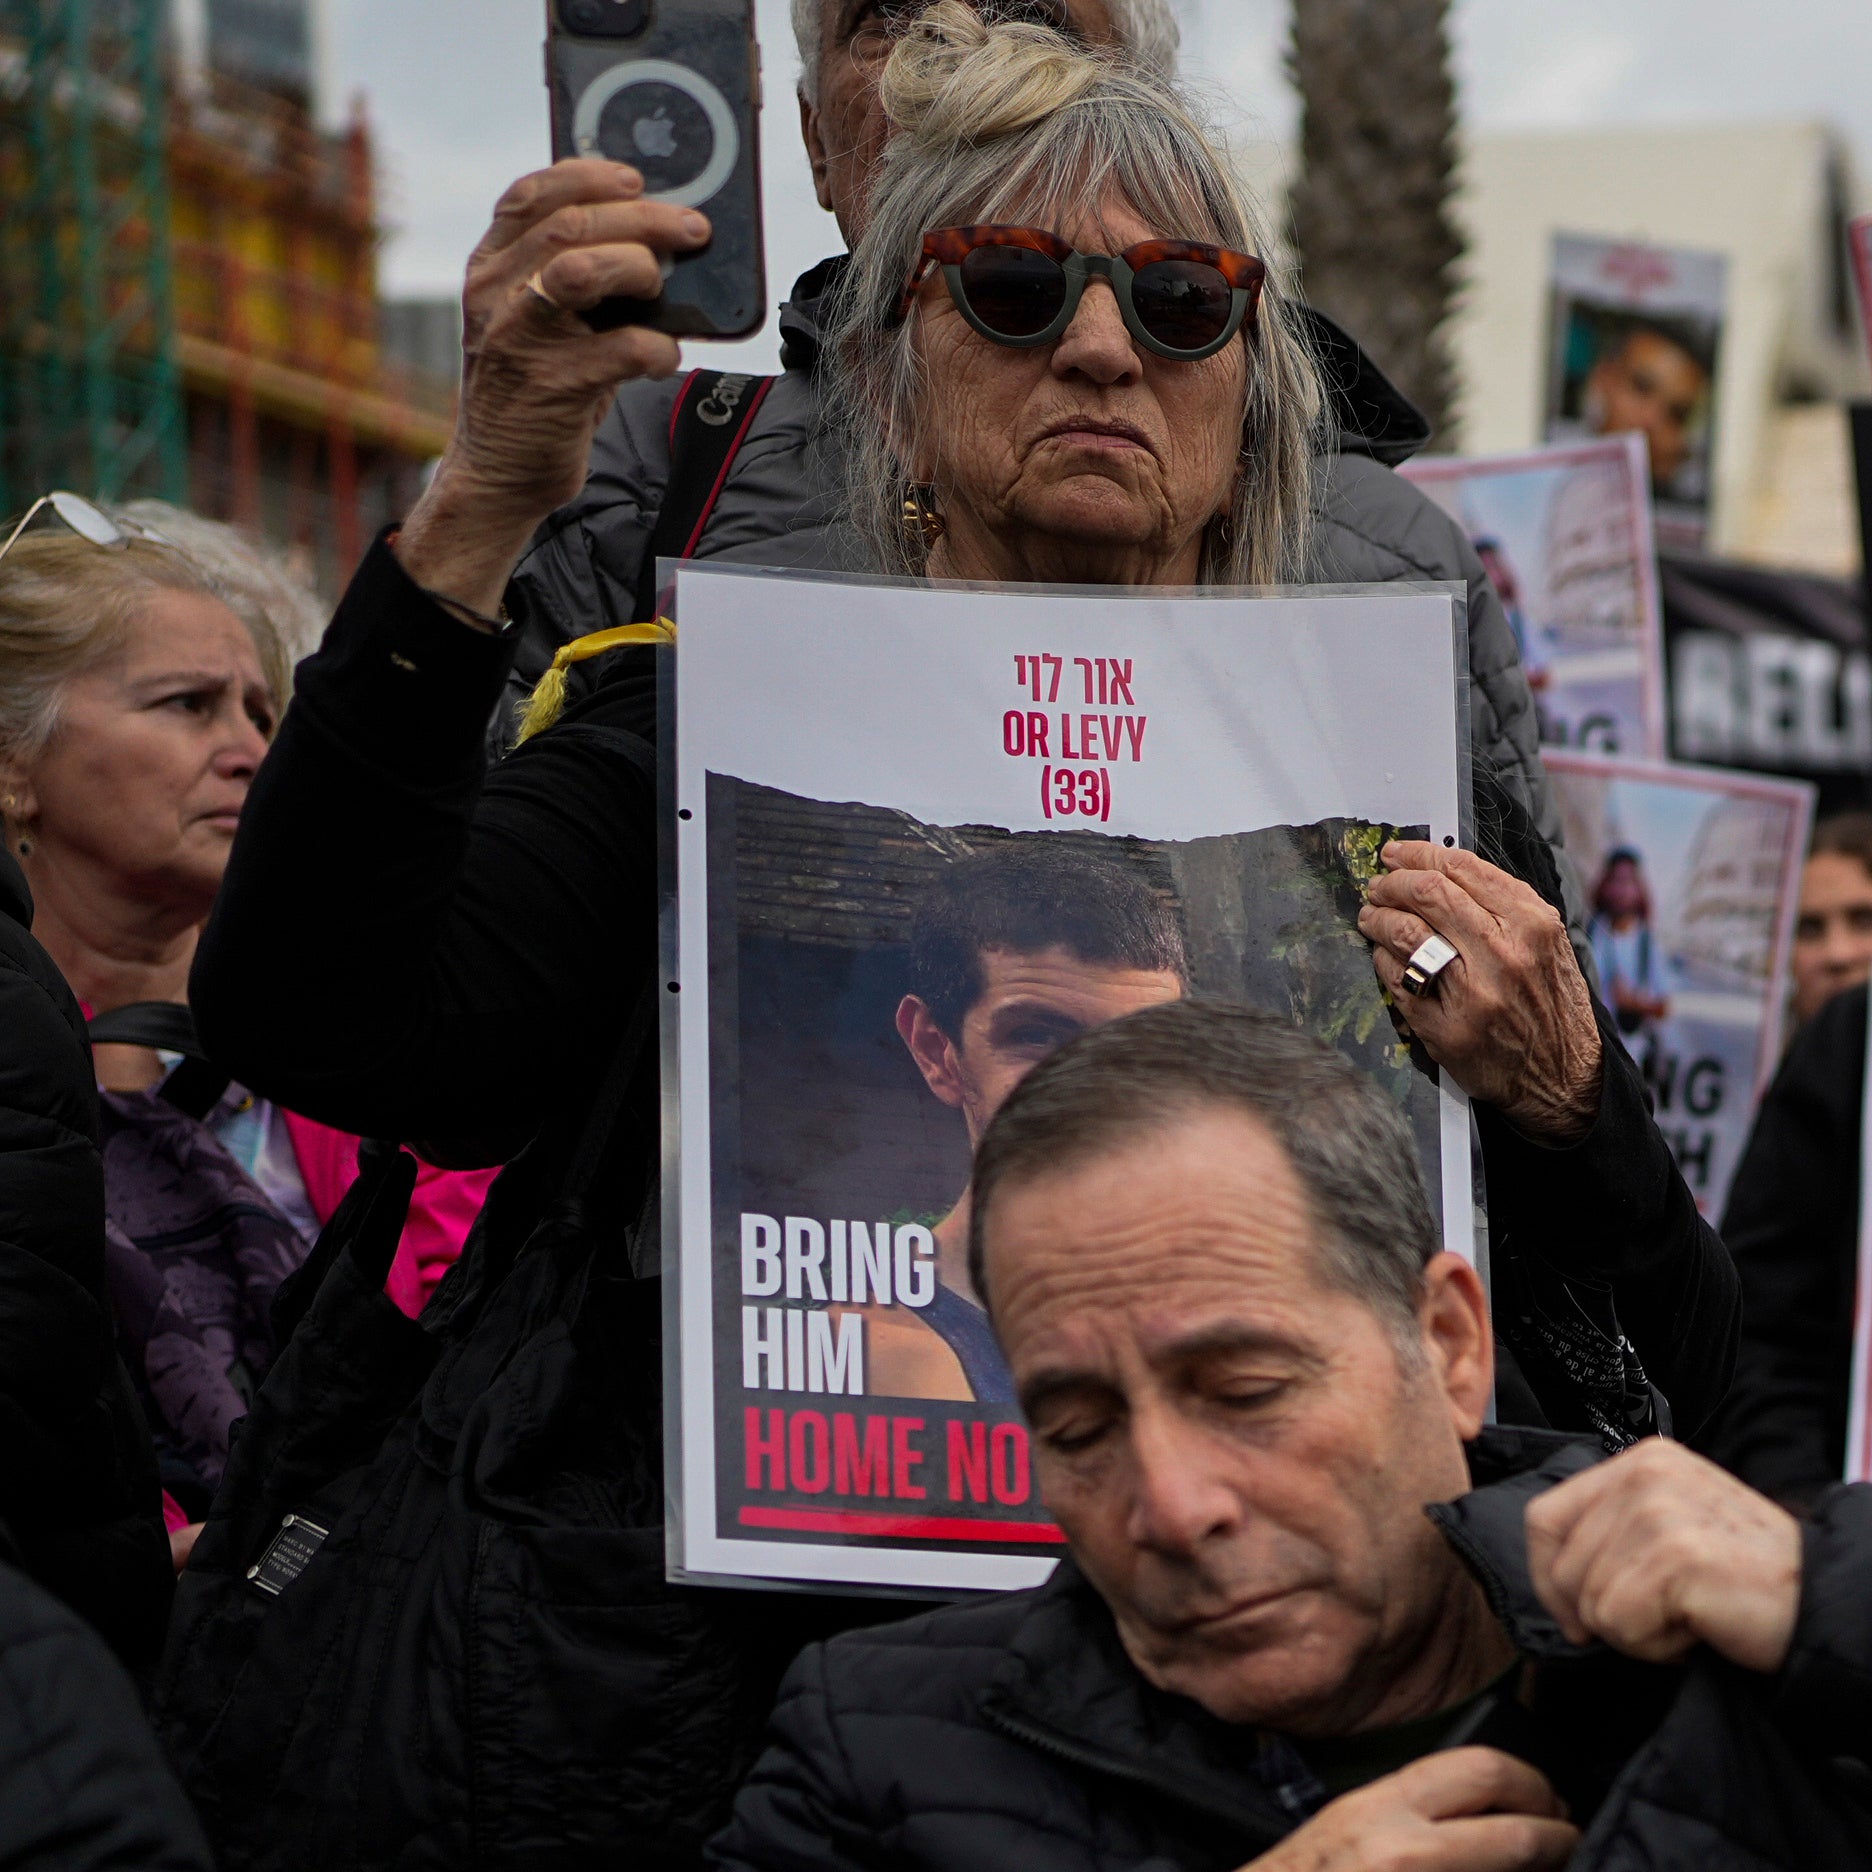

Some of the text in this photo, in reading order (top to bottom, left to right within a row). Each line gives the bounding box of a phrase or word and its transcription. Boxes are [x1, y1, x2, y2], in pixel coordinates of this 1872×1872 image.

[1013, 653, 1136, 706] אור לוי
[1003, 710, 1147, 762] OR LEVY
[1041, 764, 1111, 822] (33)
[740, 1213, 935, 1307] BRING
[742, 1305, 864, 1396] HIM
[743, 1406, 1032, 1507] HOME NO
